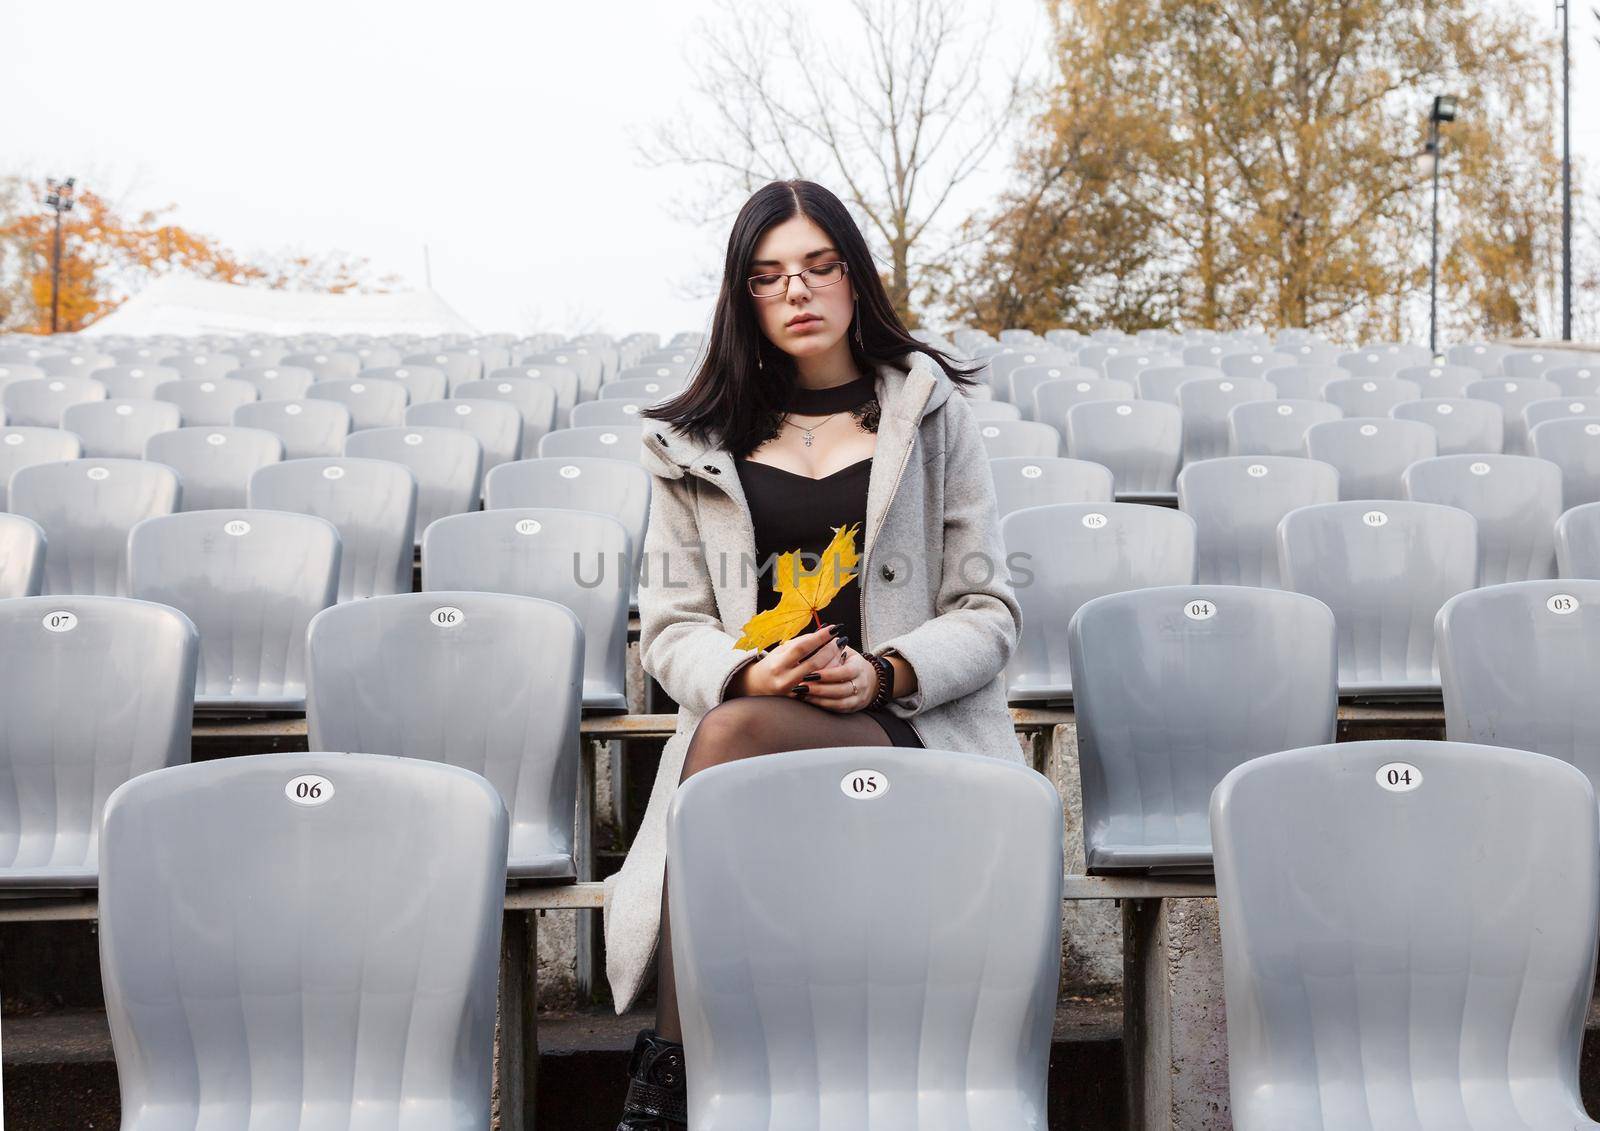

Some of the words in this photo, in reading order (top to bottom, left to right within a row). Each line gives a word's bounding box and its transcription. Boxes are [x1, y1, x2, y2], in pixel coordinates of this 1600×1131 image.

[1088, 516, 1101, 525] 05
[1369, 514, 1381, 523] 04
[231, 523, 245, 533] 08
[1191, 603, 1209, 615] 04
[1554, 598, 1571, 610] 03
[51, 615, 69, 627] 07
[437, 611, 455, 623] 06
[1387, 769, 1412, 785] 04
[297, 781, 321, 798] 06
[853, 776, 877, 793] 05
